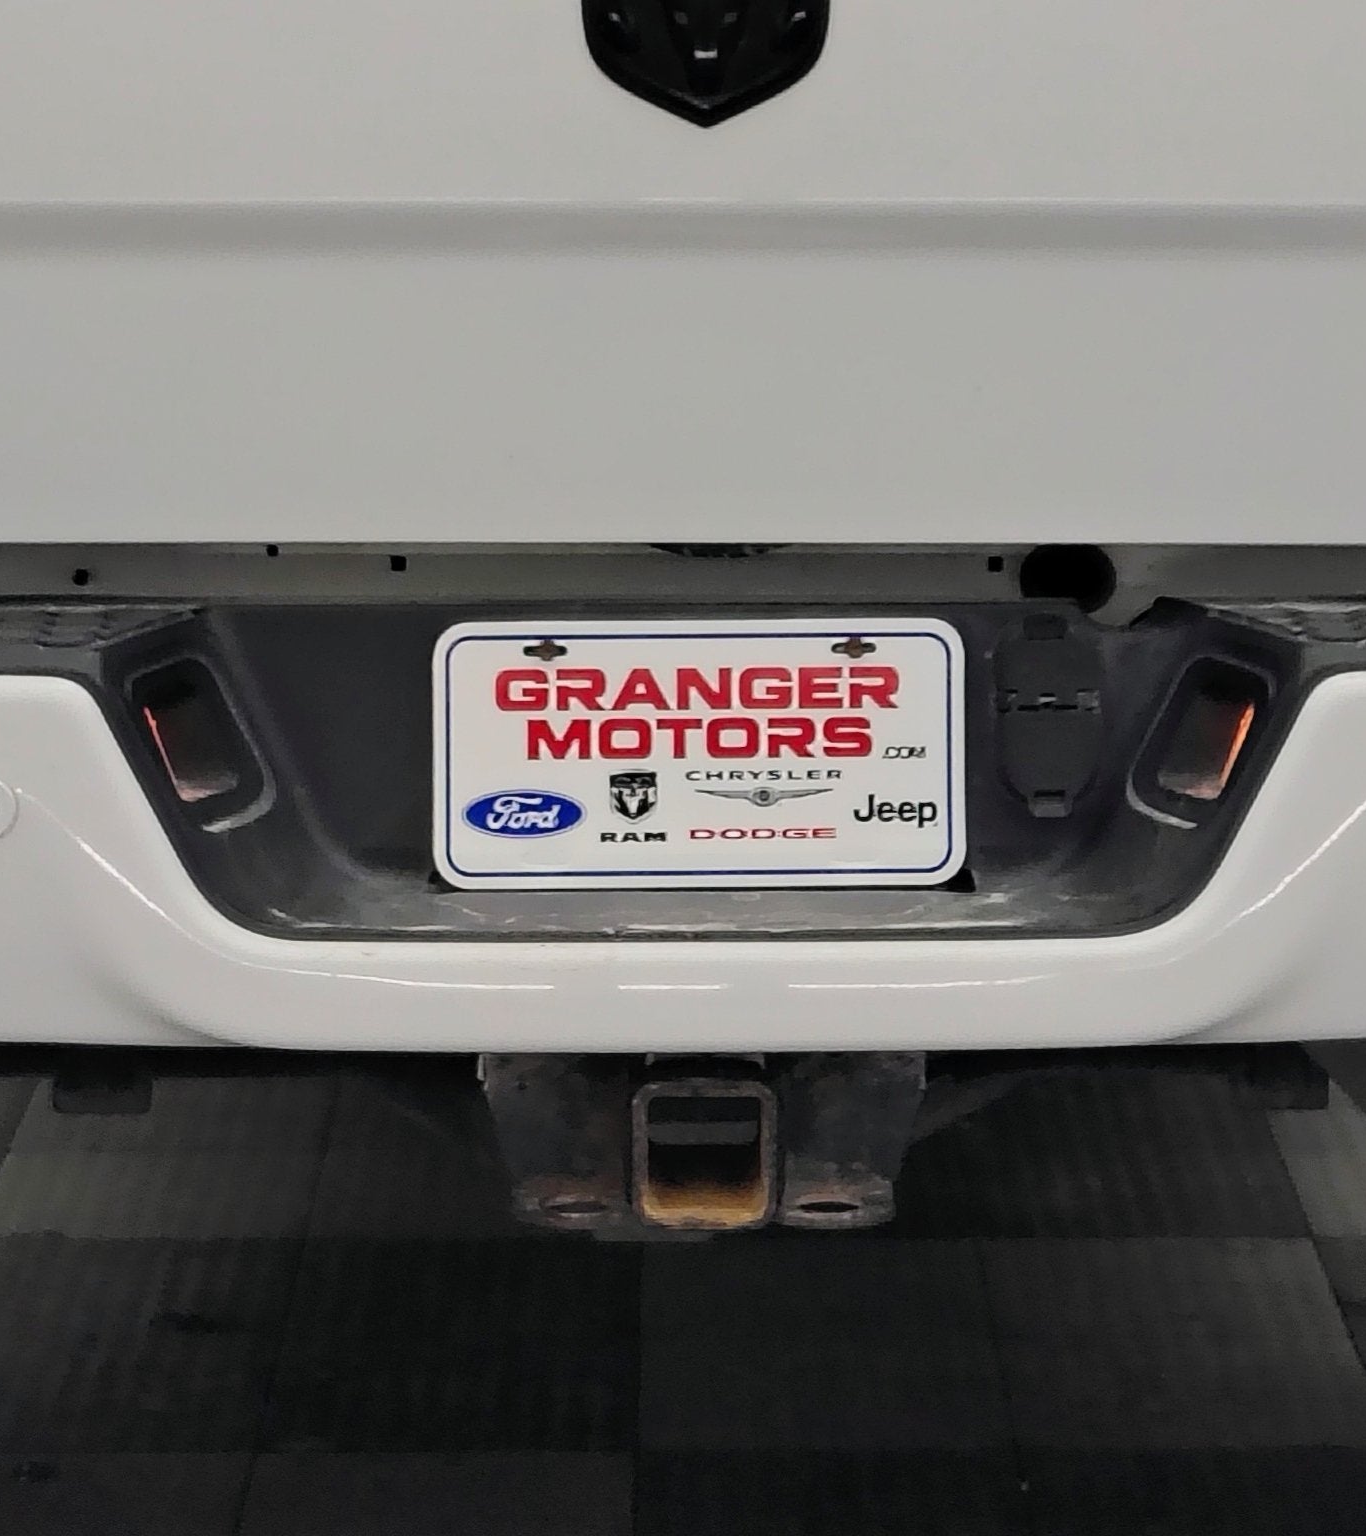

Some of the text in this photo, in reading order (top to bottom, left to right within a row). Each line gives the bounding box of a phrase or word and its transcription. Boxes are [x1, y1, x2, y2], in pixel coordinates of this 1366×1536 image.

[495, 666, 900, 712] GRANGER
[526, 717, 873, 761] MOTORS
[685, 769, 843, 781] CHRYSLER
[486, 796, 562, 830] Ford
[853, 794, 937, 828] Jeep
[600, 831, 668, 843] RAM
[689, 827, 838, 840] DODGE
